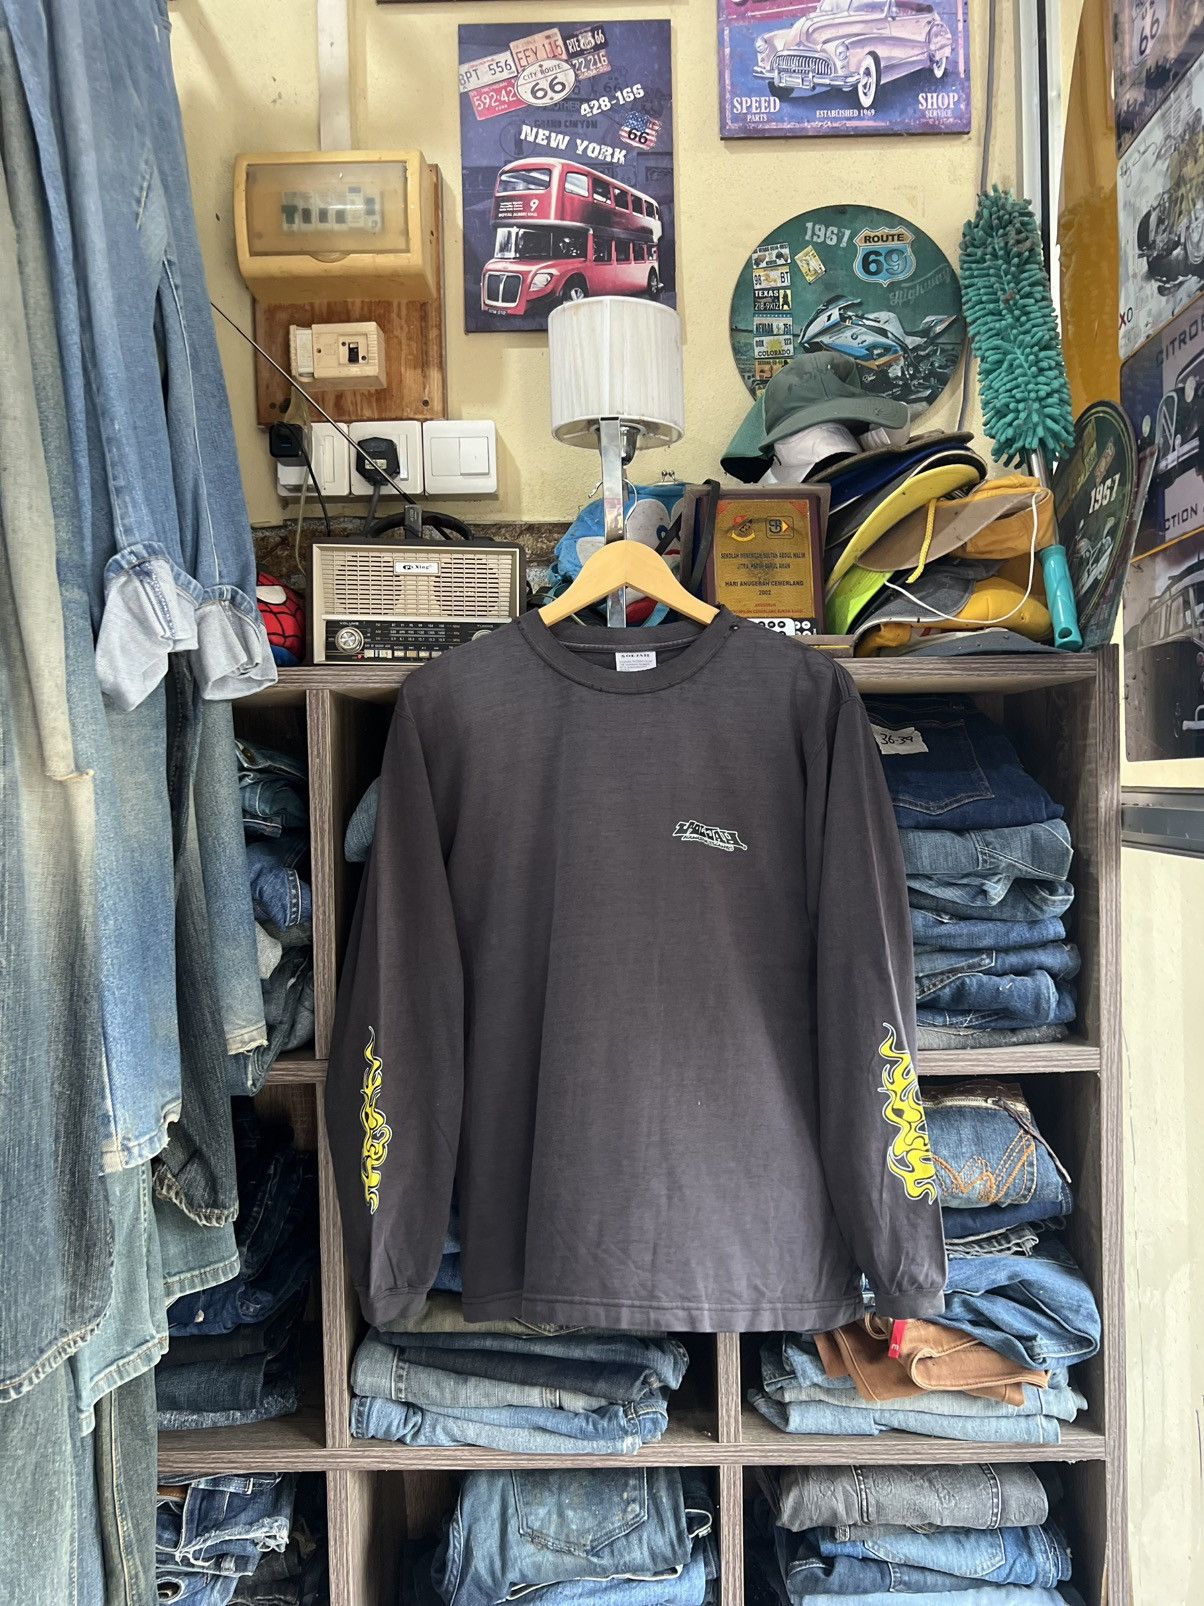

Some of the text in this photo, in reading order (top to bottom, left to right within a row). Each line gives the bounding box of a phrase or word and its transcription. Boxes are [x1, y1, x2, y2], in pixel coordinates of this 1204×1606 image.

[1139, 8, 1160, 56] 66
[487, 59, 512, 76] 556
[522, 63, 561, 81] CITY ROUTE
[530, 75, 567, 101] 66
[580, 84, 645, 118] 428-166
[733, 97, 781, 115] SPEED
[918, 93, 959, 110] SHOP
[747, 114, 768, 122] PARTS
[816, 109, 859, 118] ESTABLISHED
[925, 109, 952, 118] SERVICE
[520, 124, 627, 165] NEW YORK
[627, 127, 649, 145] 66
[530, 199, 539, 212] 9
[805, 222, 851, 248] 1967
[864, 233, 905, 244] ROUTE
[862, 248, 908, 276] 69
[758, 349, 791, 357] COLORADO
[1089, 472, 1121, 514] 1967
